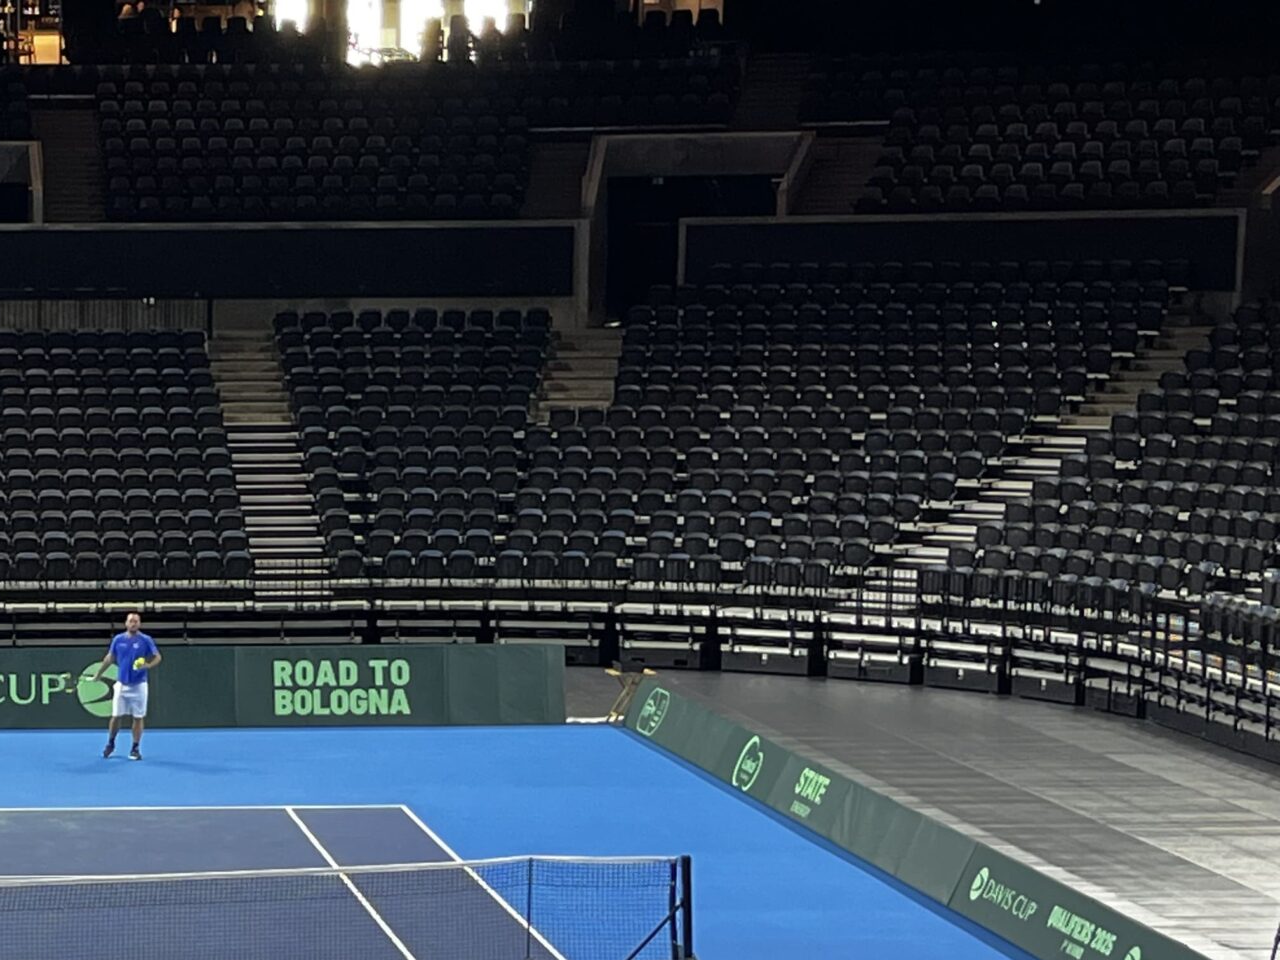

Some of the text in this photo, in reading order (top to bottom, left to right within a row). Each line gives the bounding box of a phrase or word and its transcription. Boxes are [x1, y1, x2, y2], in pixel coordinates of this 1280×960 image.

[273, 659, 411, 687] ROAD TO
[274, 688, 412, 716] BOLOGNA
[795, 767, 831, 805] STATE
[982, 879, 1038, 921] DAVIS CUP
